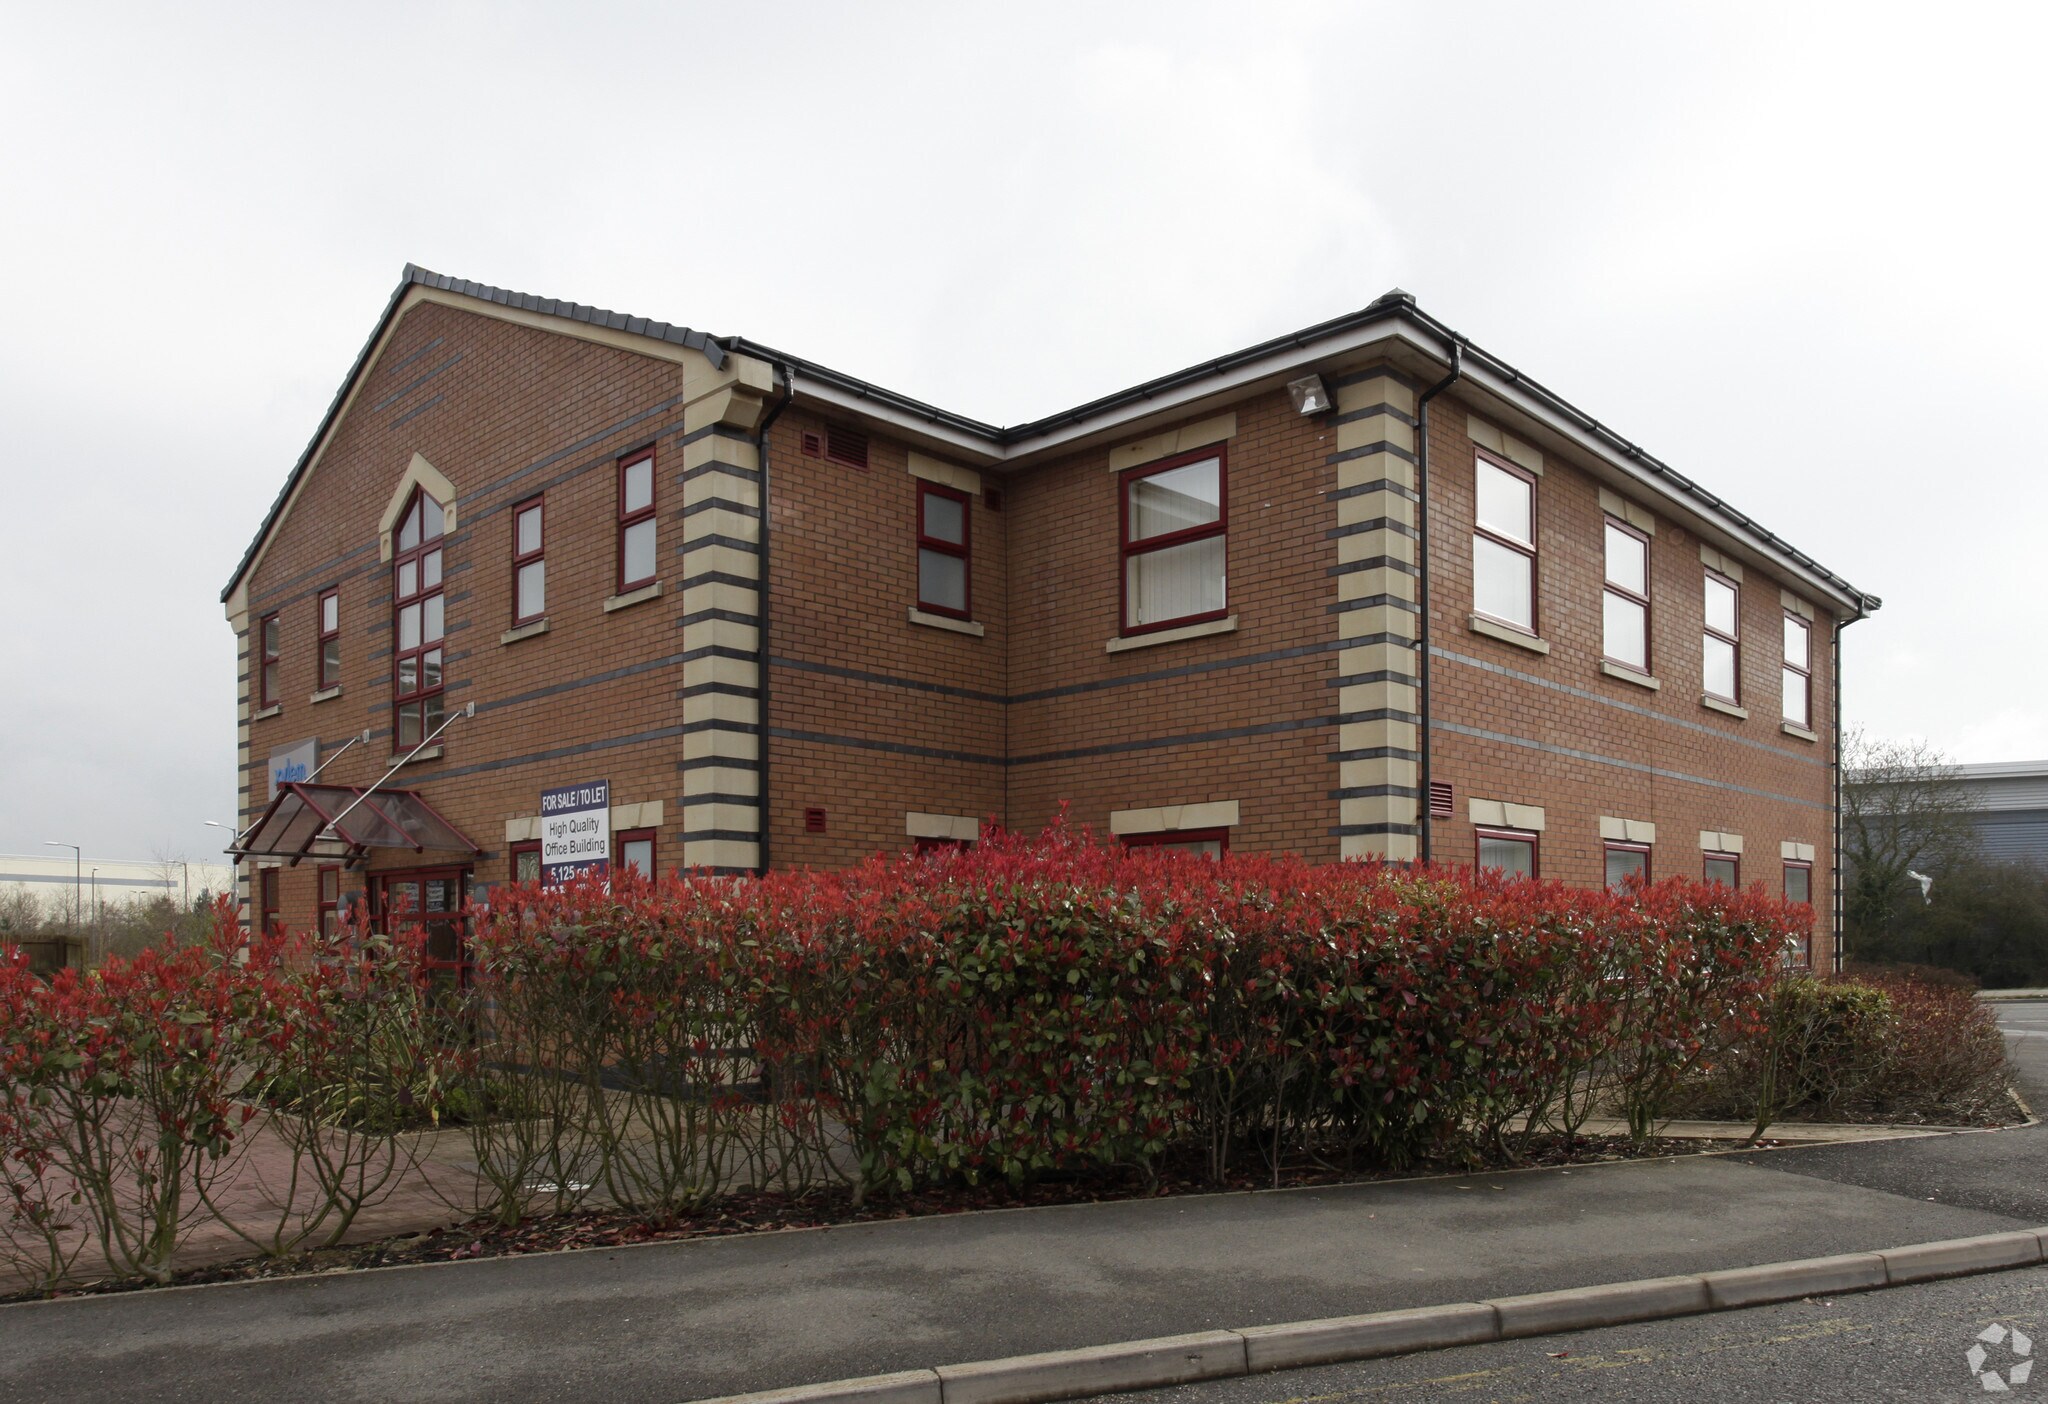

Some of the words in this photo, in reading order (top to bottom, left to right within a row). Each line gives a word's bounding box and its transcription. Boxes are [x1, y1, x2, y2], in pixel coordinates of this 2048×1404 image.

[542, 794, 557, 811] FOR
[557, 791, 576, 809] SALE
[576, 790, 580, 806] /
[580, 788, 591, 805] TO
[591, 786, 606, 804] LET
[549, 821, 568, 838] High
[569, 817, 600, 834] Quality
[545, 842, 568, 857] Office
[569, 837, 605, 854] Building
[551, 865, 575, 884] 5,125
